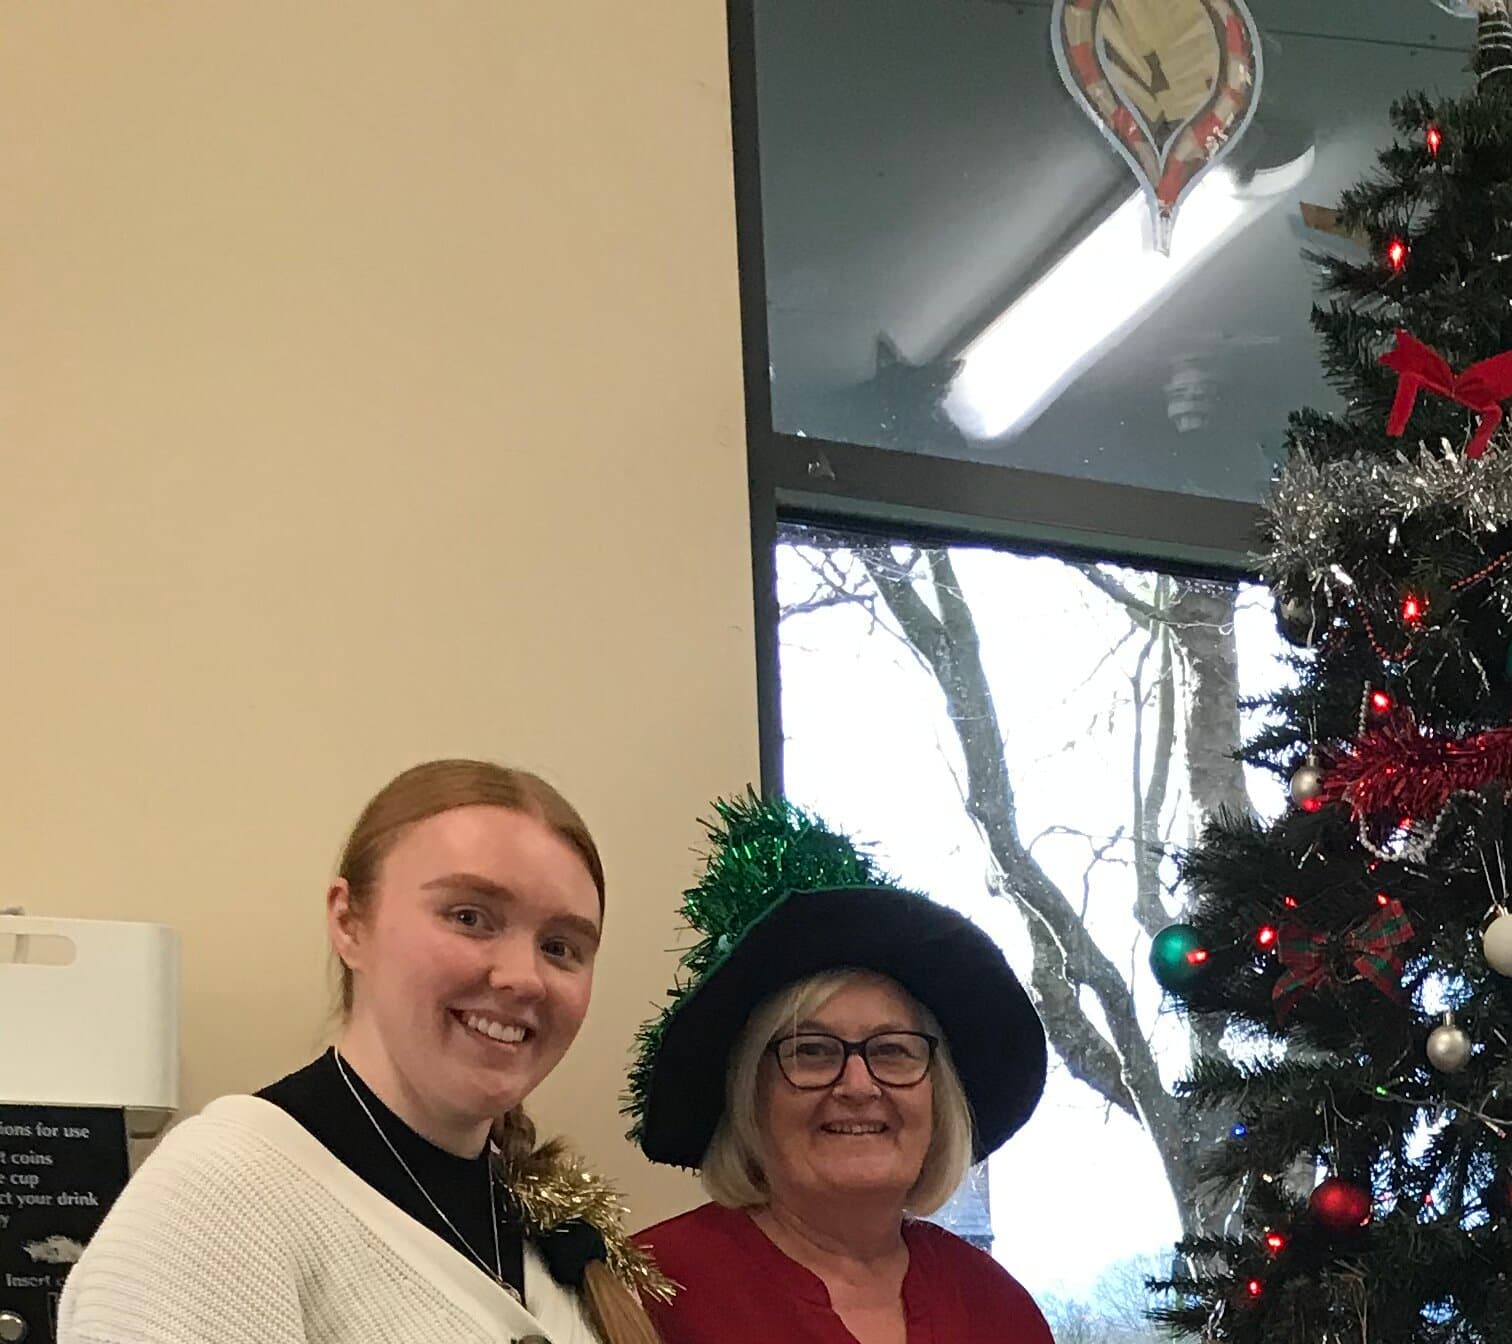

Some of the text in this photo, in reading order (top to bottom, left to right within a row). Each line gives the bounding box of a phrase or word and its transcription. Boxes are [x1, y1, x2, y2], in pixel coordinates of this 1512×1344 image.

[36, 1122, 59, 1138] for
[63, 1127, 90, 1139] use
[10, 1150, 53, 1165] coins
[10, 1173, 39, 1189] cup
[16, 1194, 53, 1208] your
[56, 1191, 99, 1206] drink
[5, 1273, 51, 1288] Insert
